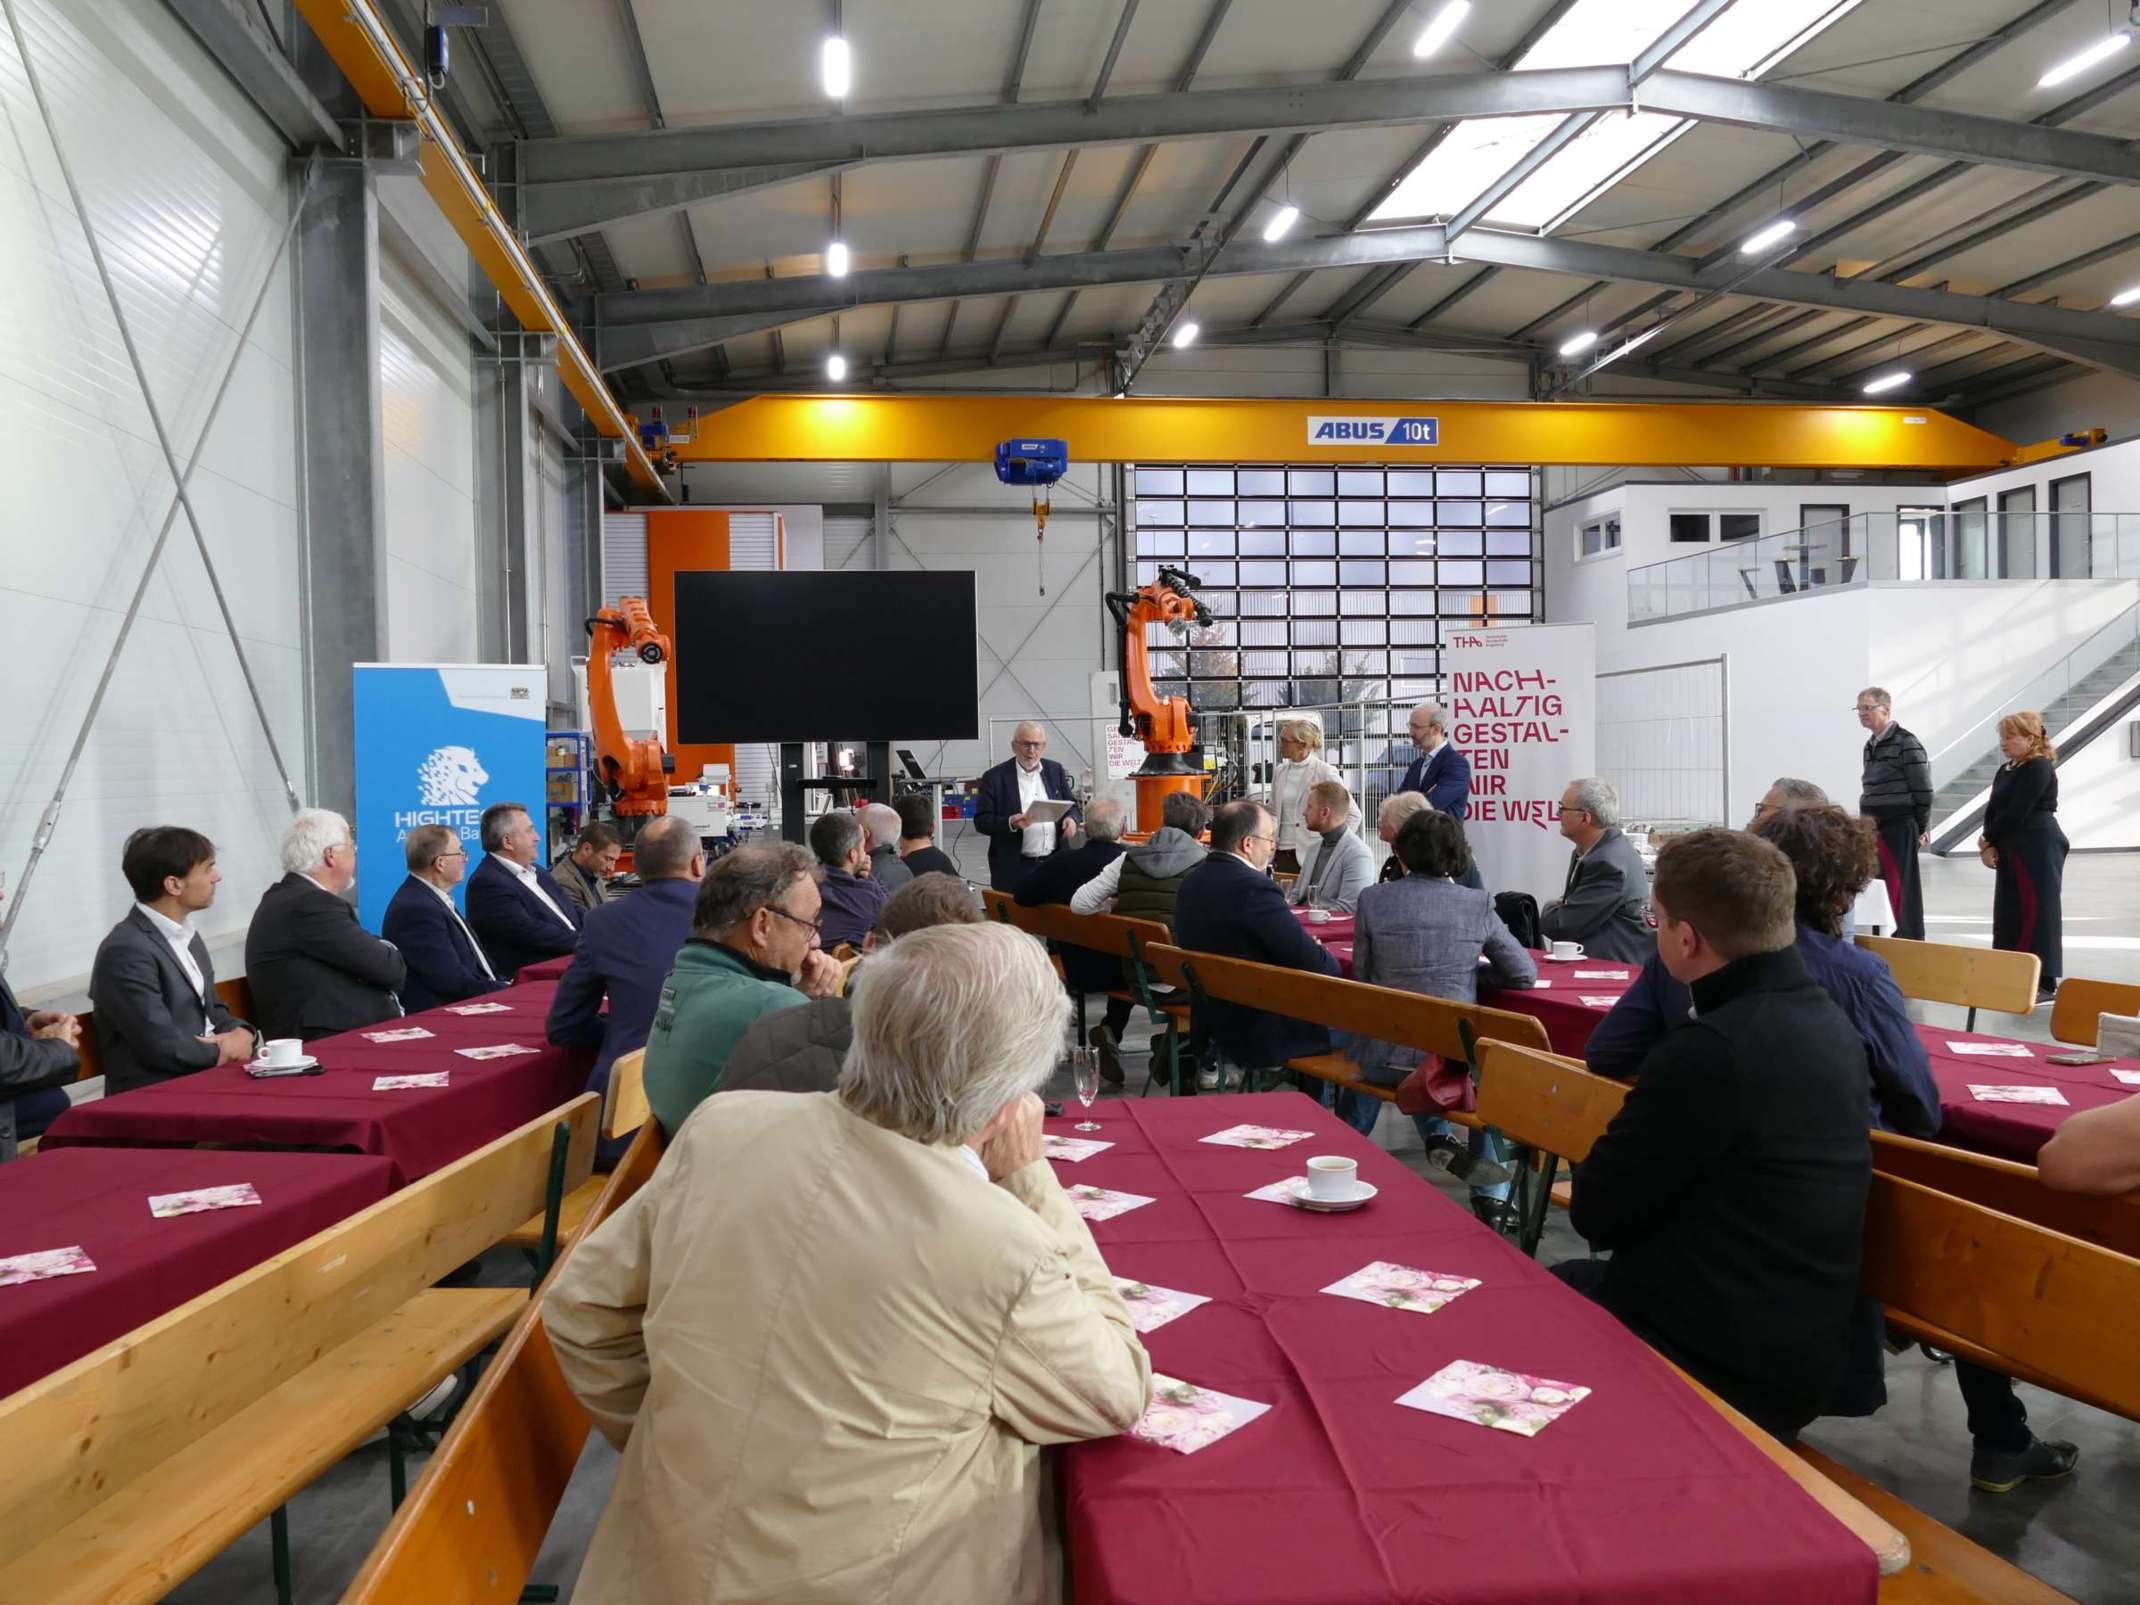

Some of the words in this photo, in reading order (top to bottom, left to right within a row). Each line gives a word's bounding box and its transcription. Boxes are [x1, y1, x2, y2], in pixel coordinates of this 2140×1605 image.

[1315, 422, 1385, 439] ABUS
[1402, 422, 1431, 441] 10t
[1453, 669, 1556, 693] NACH-
[1454, 695, 1563, 719] HALTIG
[1453, 721, 1569, 745] GESTAL-
[395, 809, 485, 828] HIGHTE
[1502, 800, 1561, 830] WEL
